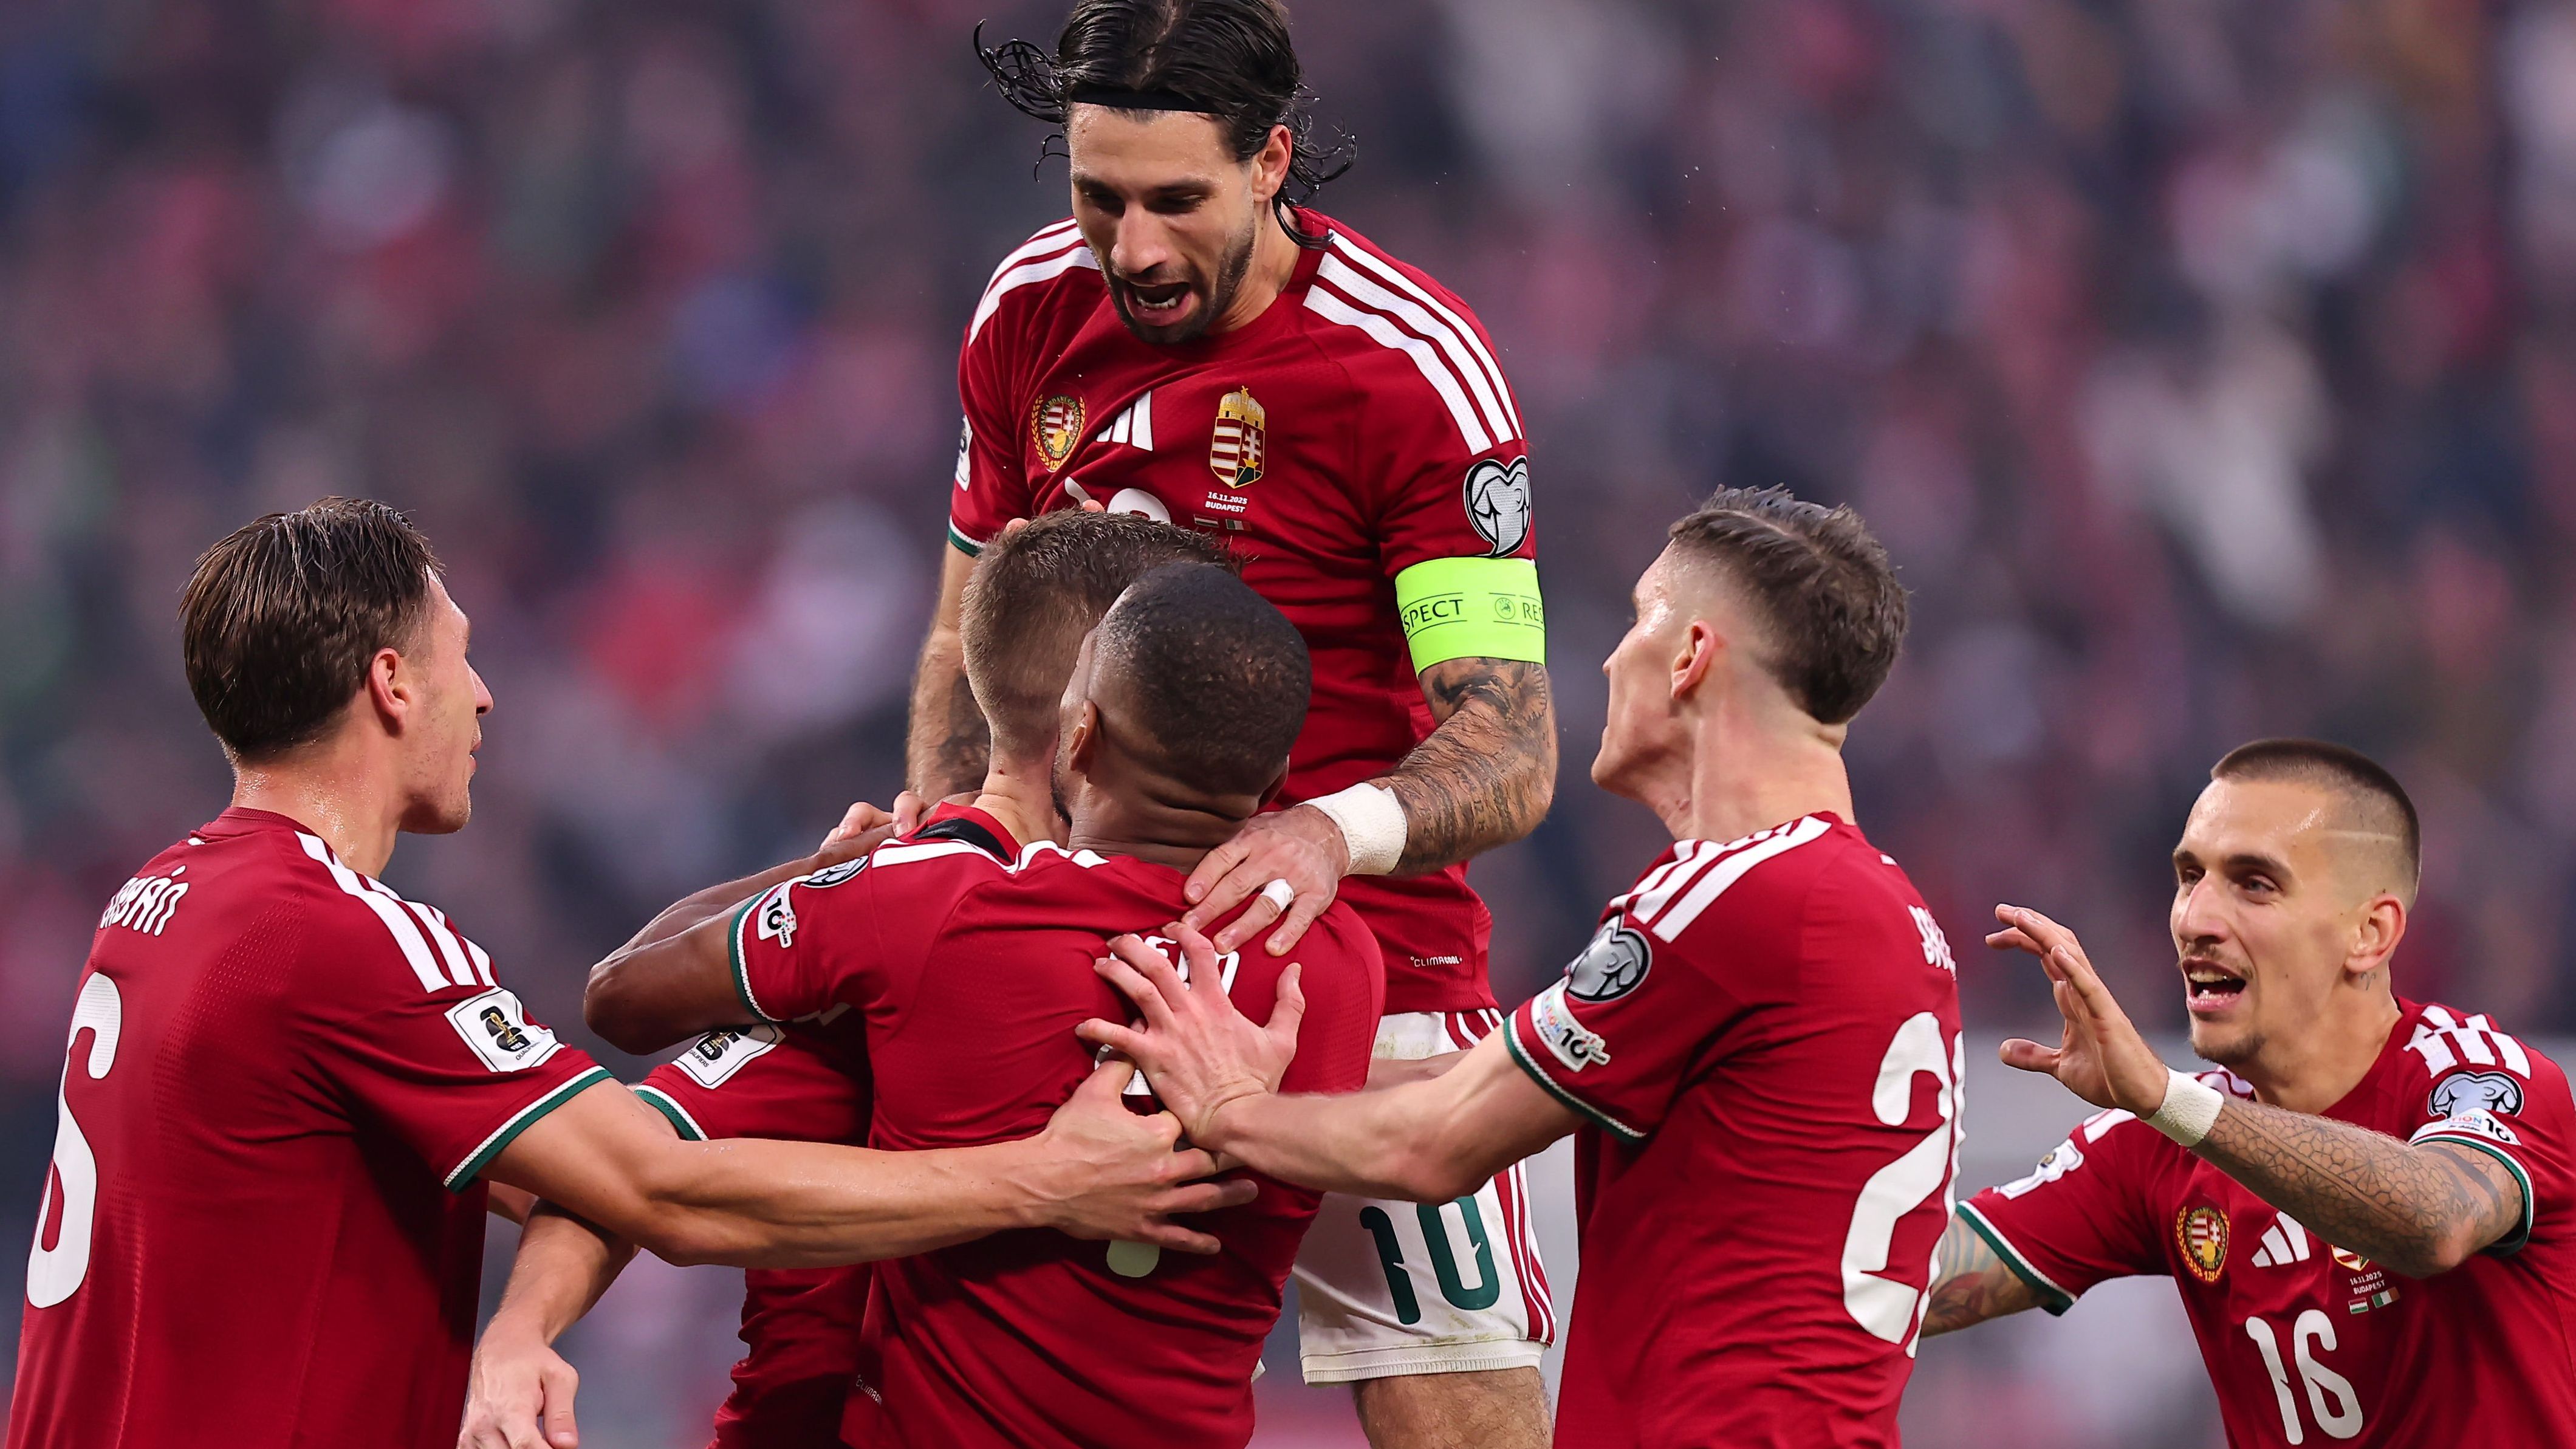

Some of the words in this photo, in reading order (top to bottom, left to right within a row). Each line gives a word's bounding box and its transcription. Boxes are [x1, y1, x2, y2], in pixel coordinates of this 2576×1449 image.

[1205, 501, 1245, 513] BUDAPEST
[1207, 491, 1248, 505] 16.11.2025
[701, 1043, 715, 1056] FIFA
[26, 972, 122, 1309] 6
[1840, 1011, 1967, 1359] 2
[1359, 1195, 1499, 1325] 10
[2353, 1279, 2385, 1295] BUDAPEST
[2245, 1309, 2363, 1445] 16
